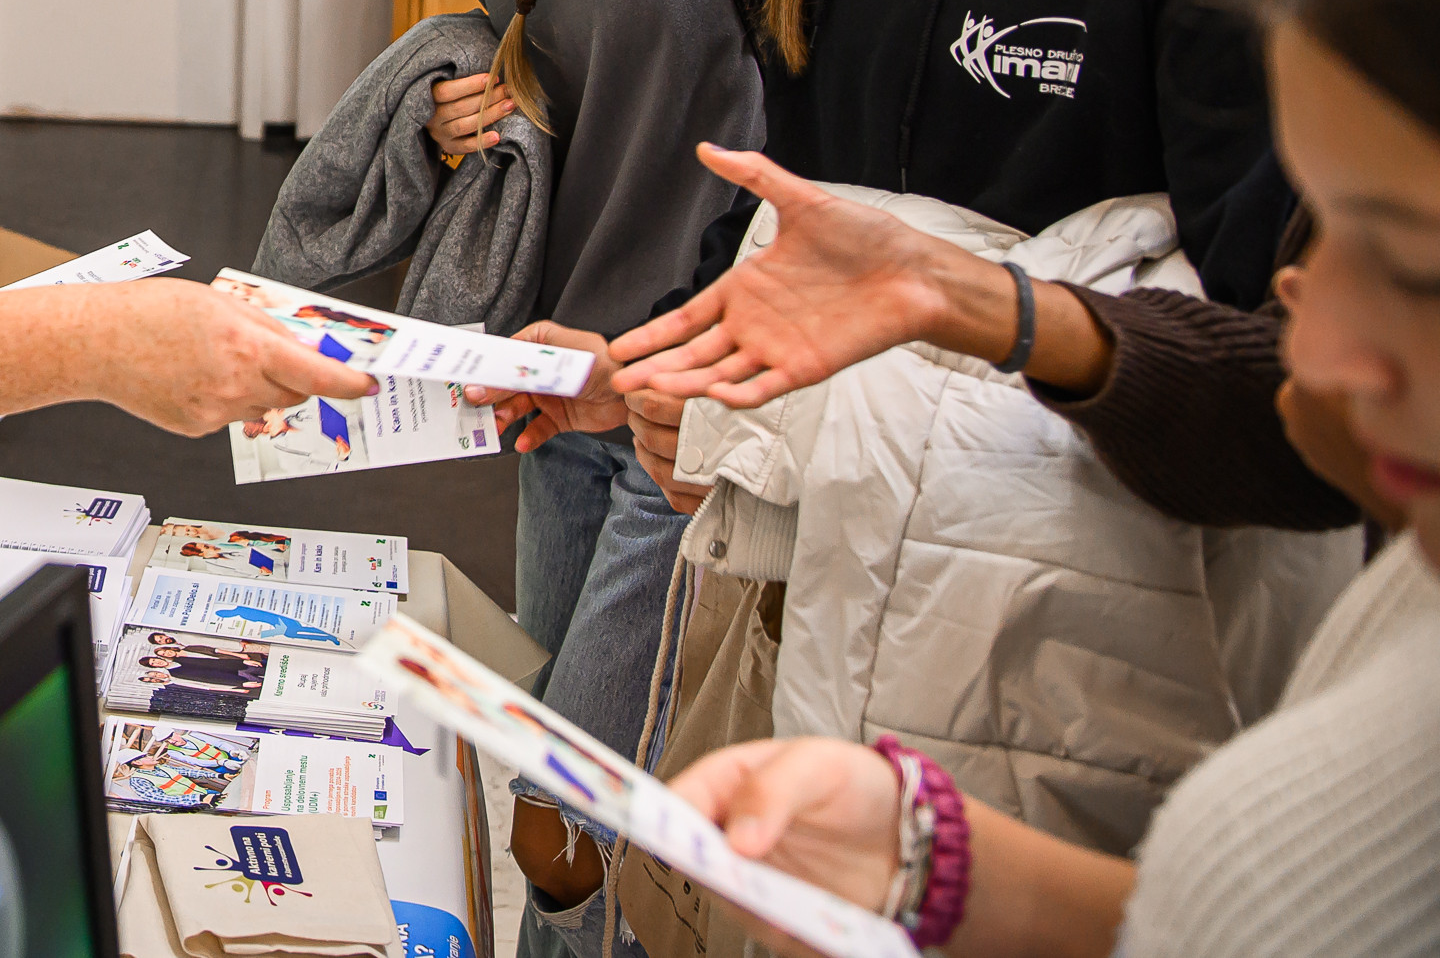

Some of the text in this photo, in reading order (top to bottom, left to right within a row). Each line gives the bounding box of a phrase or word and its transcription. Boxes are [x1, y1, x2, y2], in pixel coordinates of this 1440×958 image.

[995, 44, 1043, 57] PLESNO
[386, 375, 397, 393] kak
[315, 544, 323, 556] kako
[300, 755, 308, 773] mestu
[281, 769, 295, 811] Usposabljanje
[296, 775, 306, 803] delovnem
[263, 790, 272, 809] Program
[254, 832, 272, 848] poti
[242, 836, 262, 875] Aktivno na
